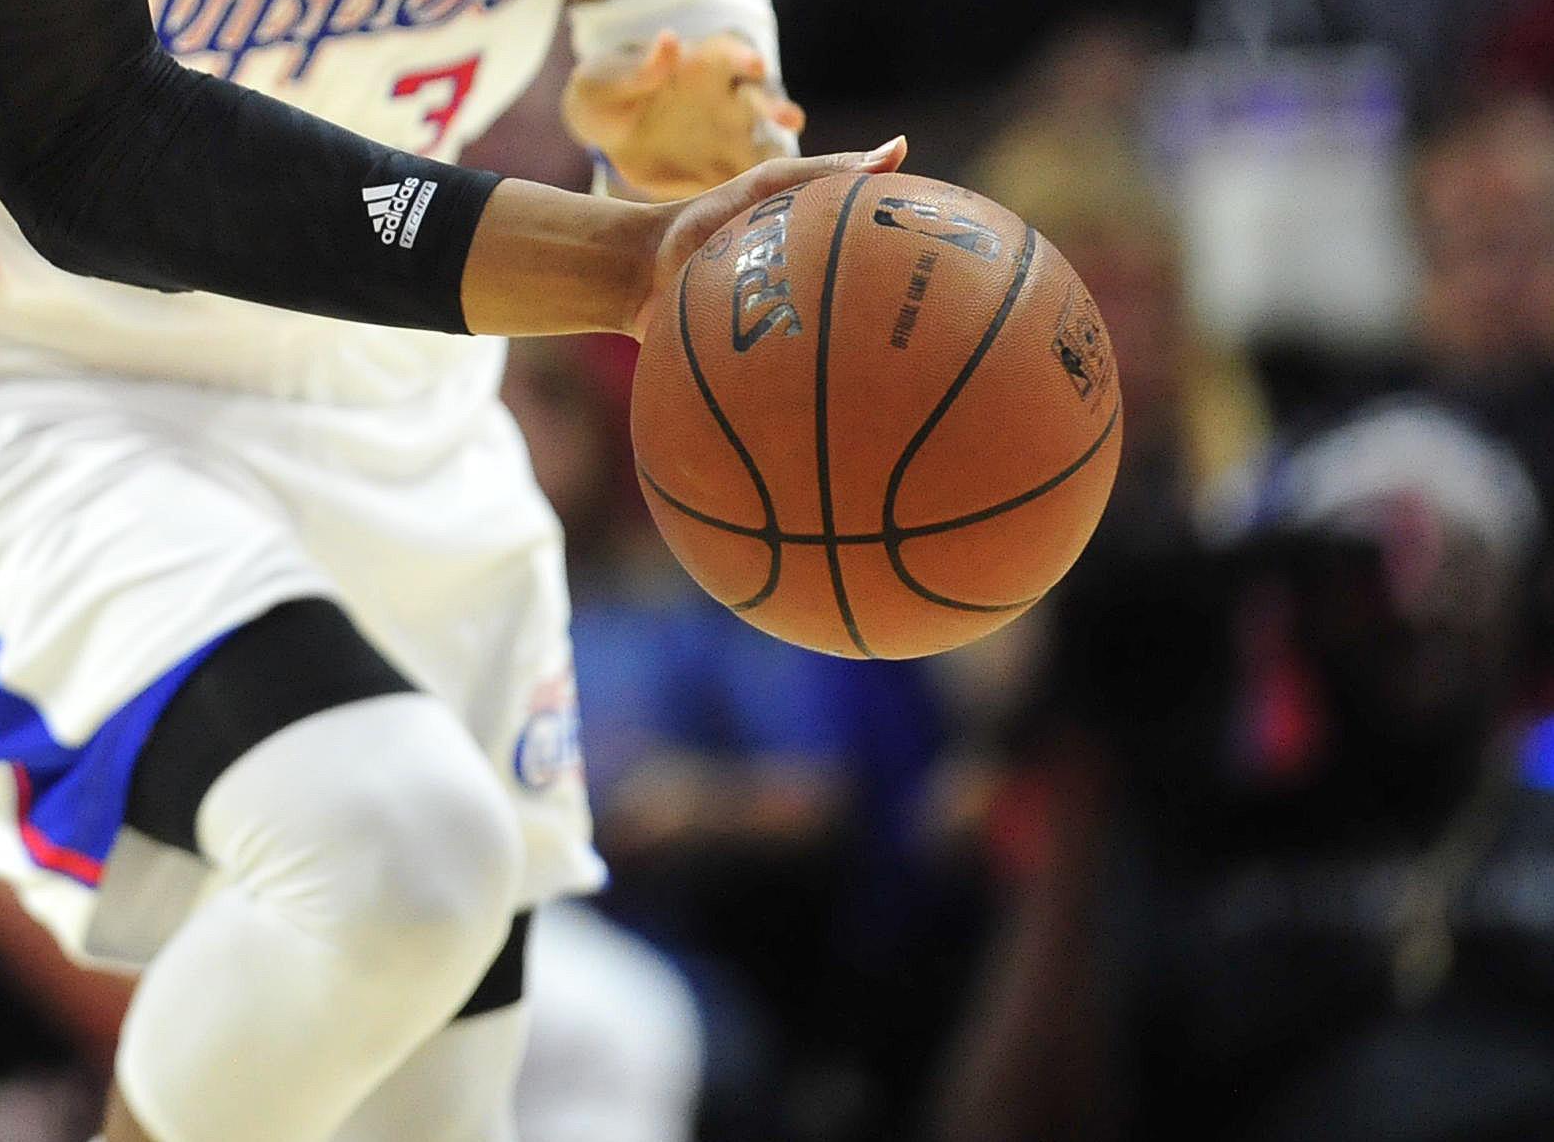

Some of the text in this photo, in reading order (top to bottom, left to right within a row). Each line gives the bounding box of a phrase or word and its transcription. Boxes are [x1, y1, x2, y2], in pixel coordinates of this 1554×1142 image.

[391, 54, 481, 156] 3
[380, 176, 421, 246] adidas
[732, 181, 809, 352] SPALD
